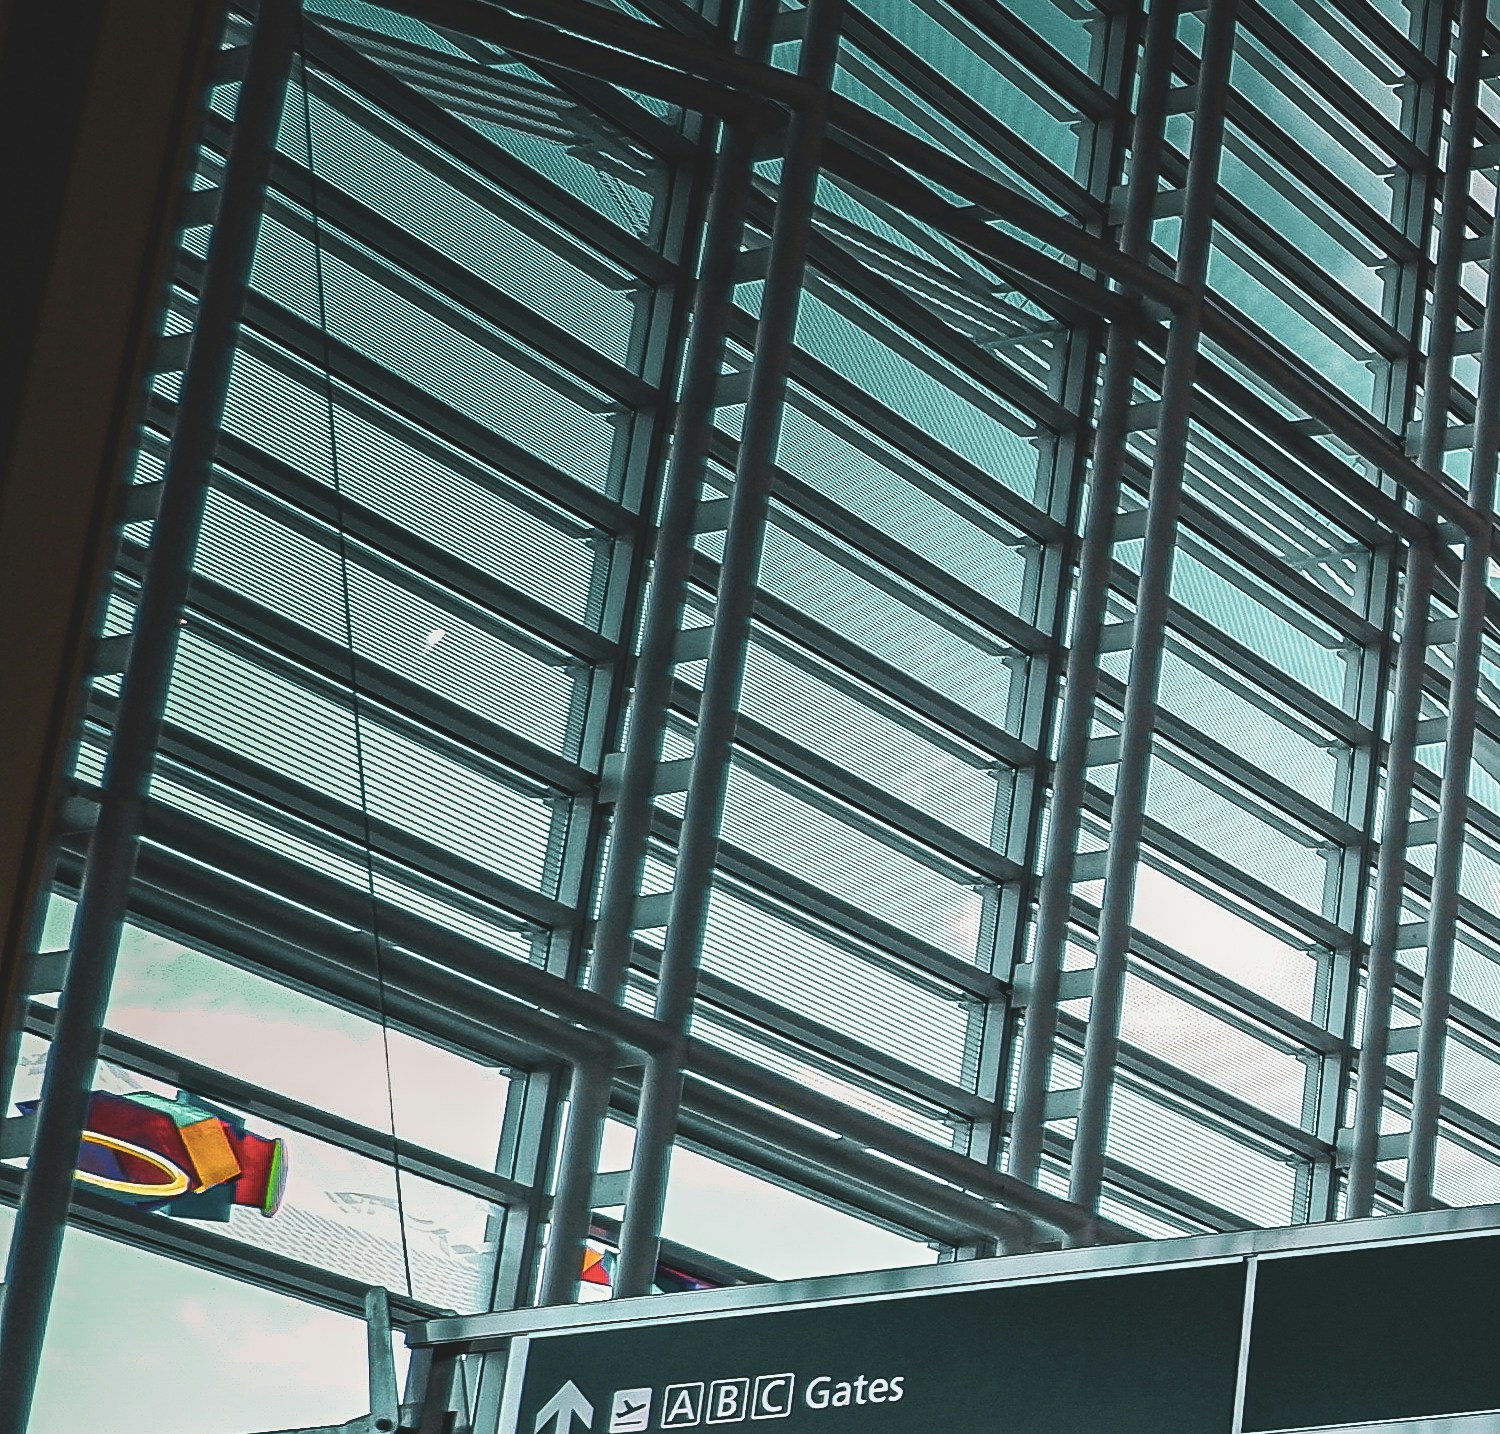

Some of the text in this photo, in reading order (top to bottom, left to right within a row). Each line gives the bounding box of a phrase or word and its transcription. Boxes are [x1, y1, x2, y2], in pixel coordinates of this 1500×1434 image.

[667, 1374, 904, 1422] A B C Gates
